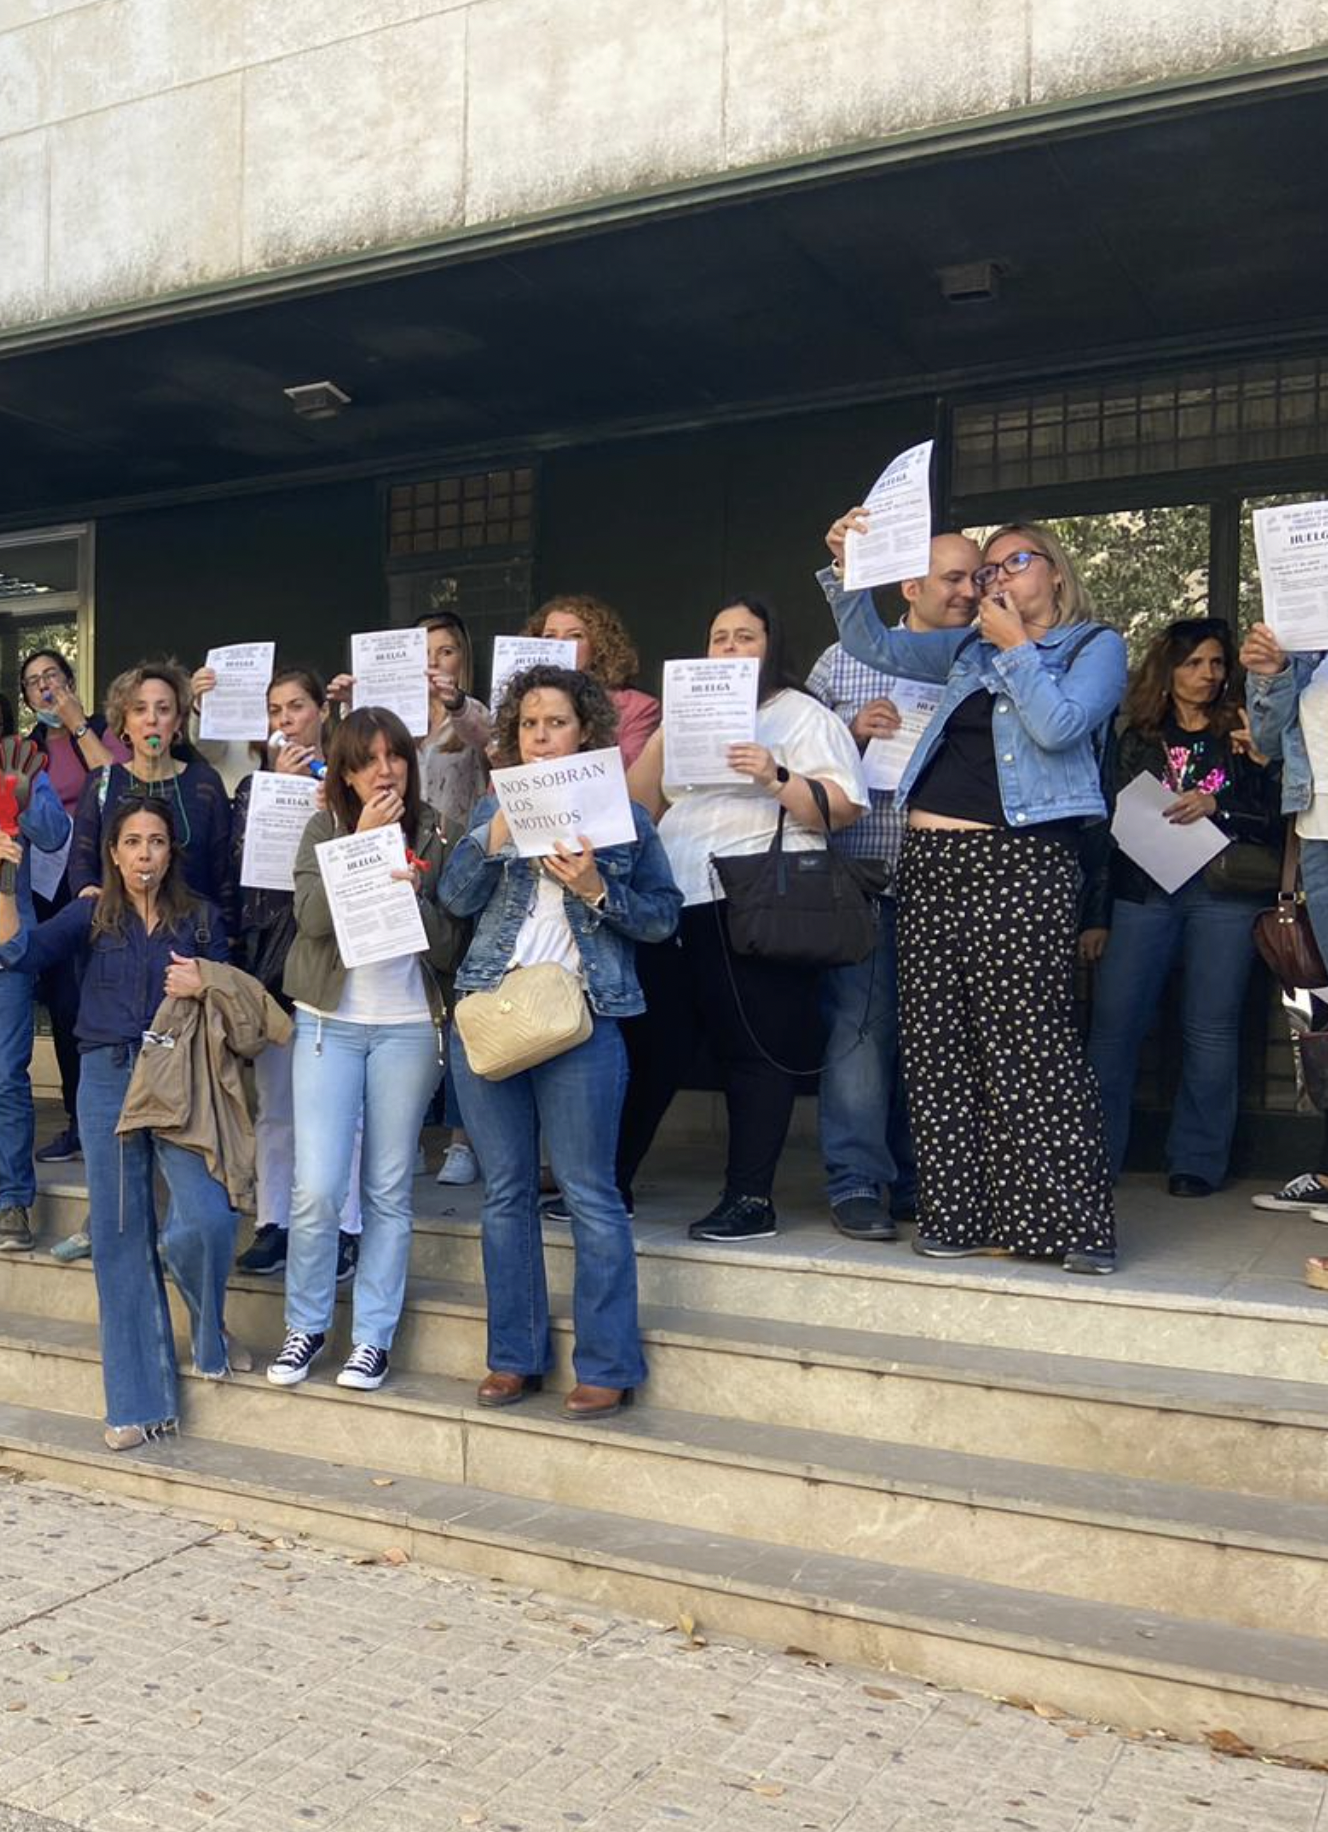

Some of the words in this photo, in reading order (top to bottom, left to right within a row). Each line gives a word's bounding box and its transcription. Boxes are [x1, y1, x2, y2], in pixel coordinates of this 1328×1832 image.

[1289, 530, 1328, 545] HUELG
[691, 682, 731, 693] HUELGA
[500, 777, 530, 795] NOS
[532, 762, 606, 790] SOBRAN
[275, 797, 310, 807] HUELGA
[506, 797, 534, 813] LOS
[513, 809, 582, 831] MOTIVOS
[346, 853, 383, 871] HUELGA
